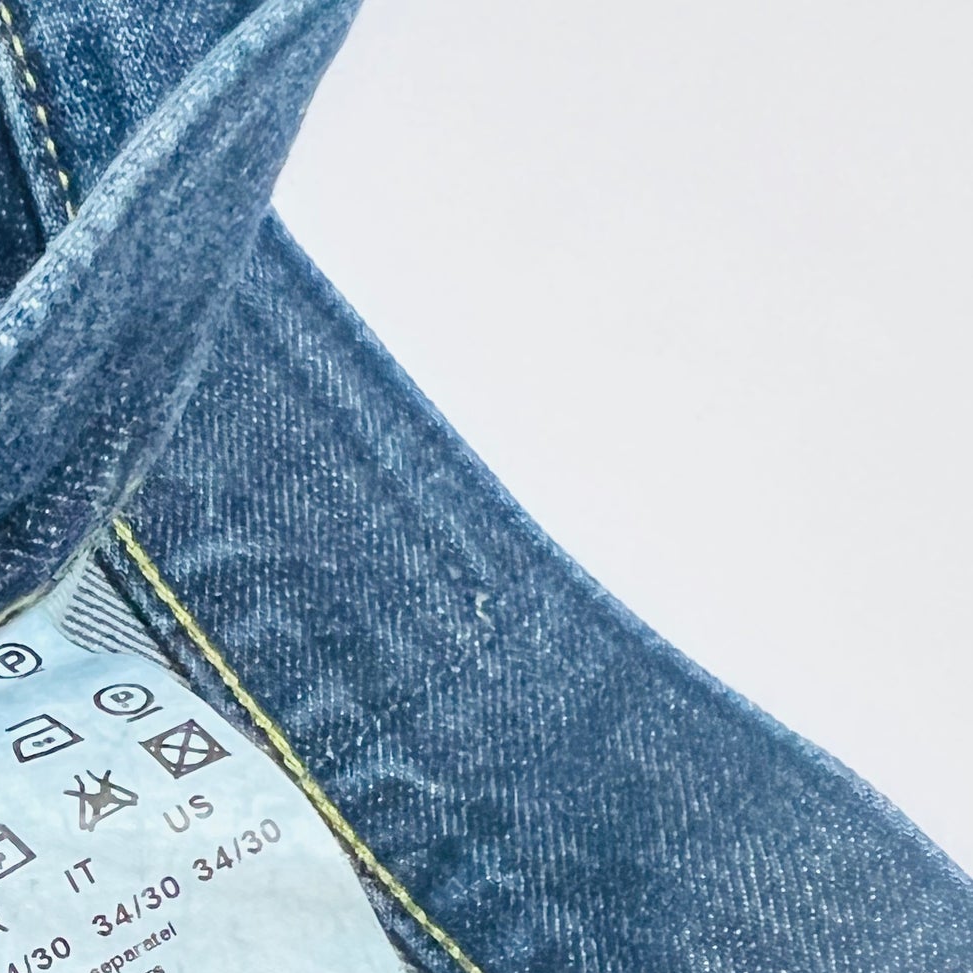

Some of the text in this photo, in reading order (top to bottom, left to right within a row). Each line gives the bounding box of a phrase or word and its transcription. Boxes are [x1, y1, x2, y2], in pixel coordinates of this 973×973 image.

[64, 857, 96, 893] IT
[162, 794, 214, 833] US
[91, 875, 181, 937] 34/30
[192, 818, 282, 881] 34/30
